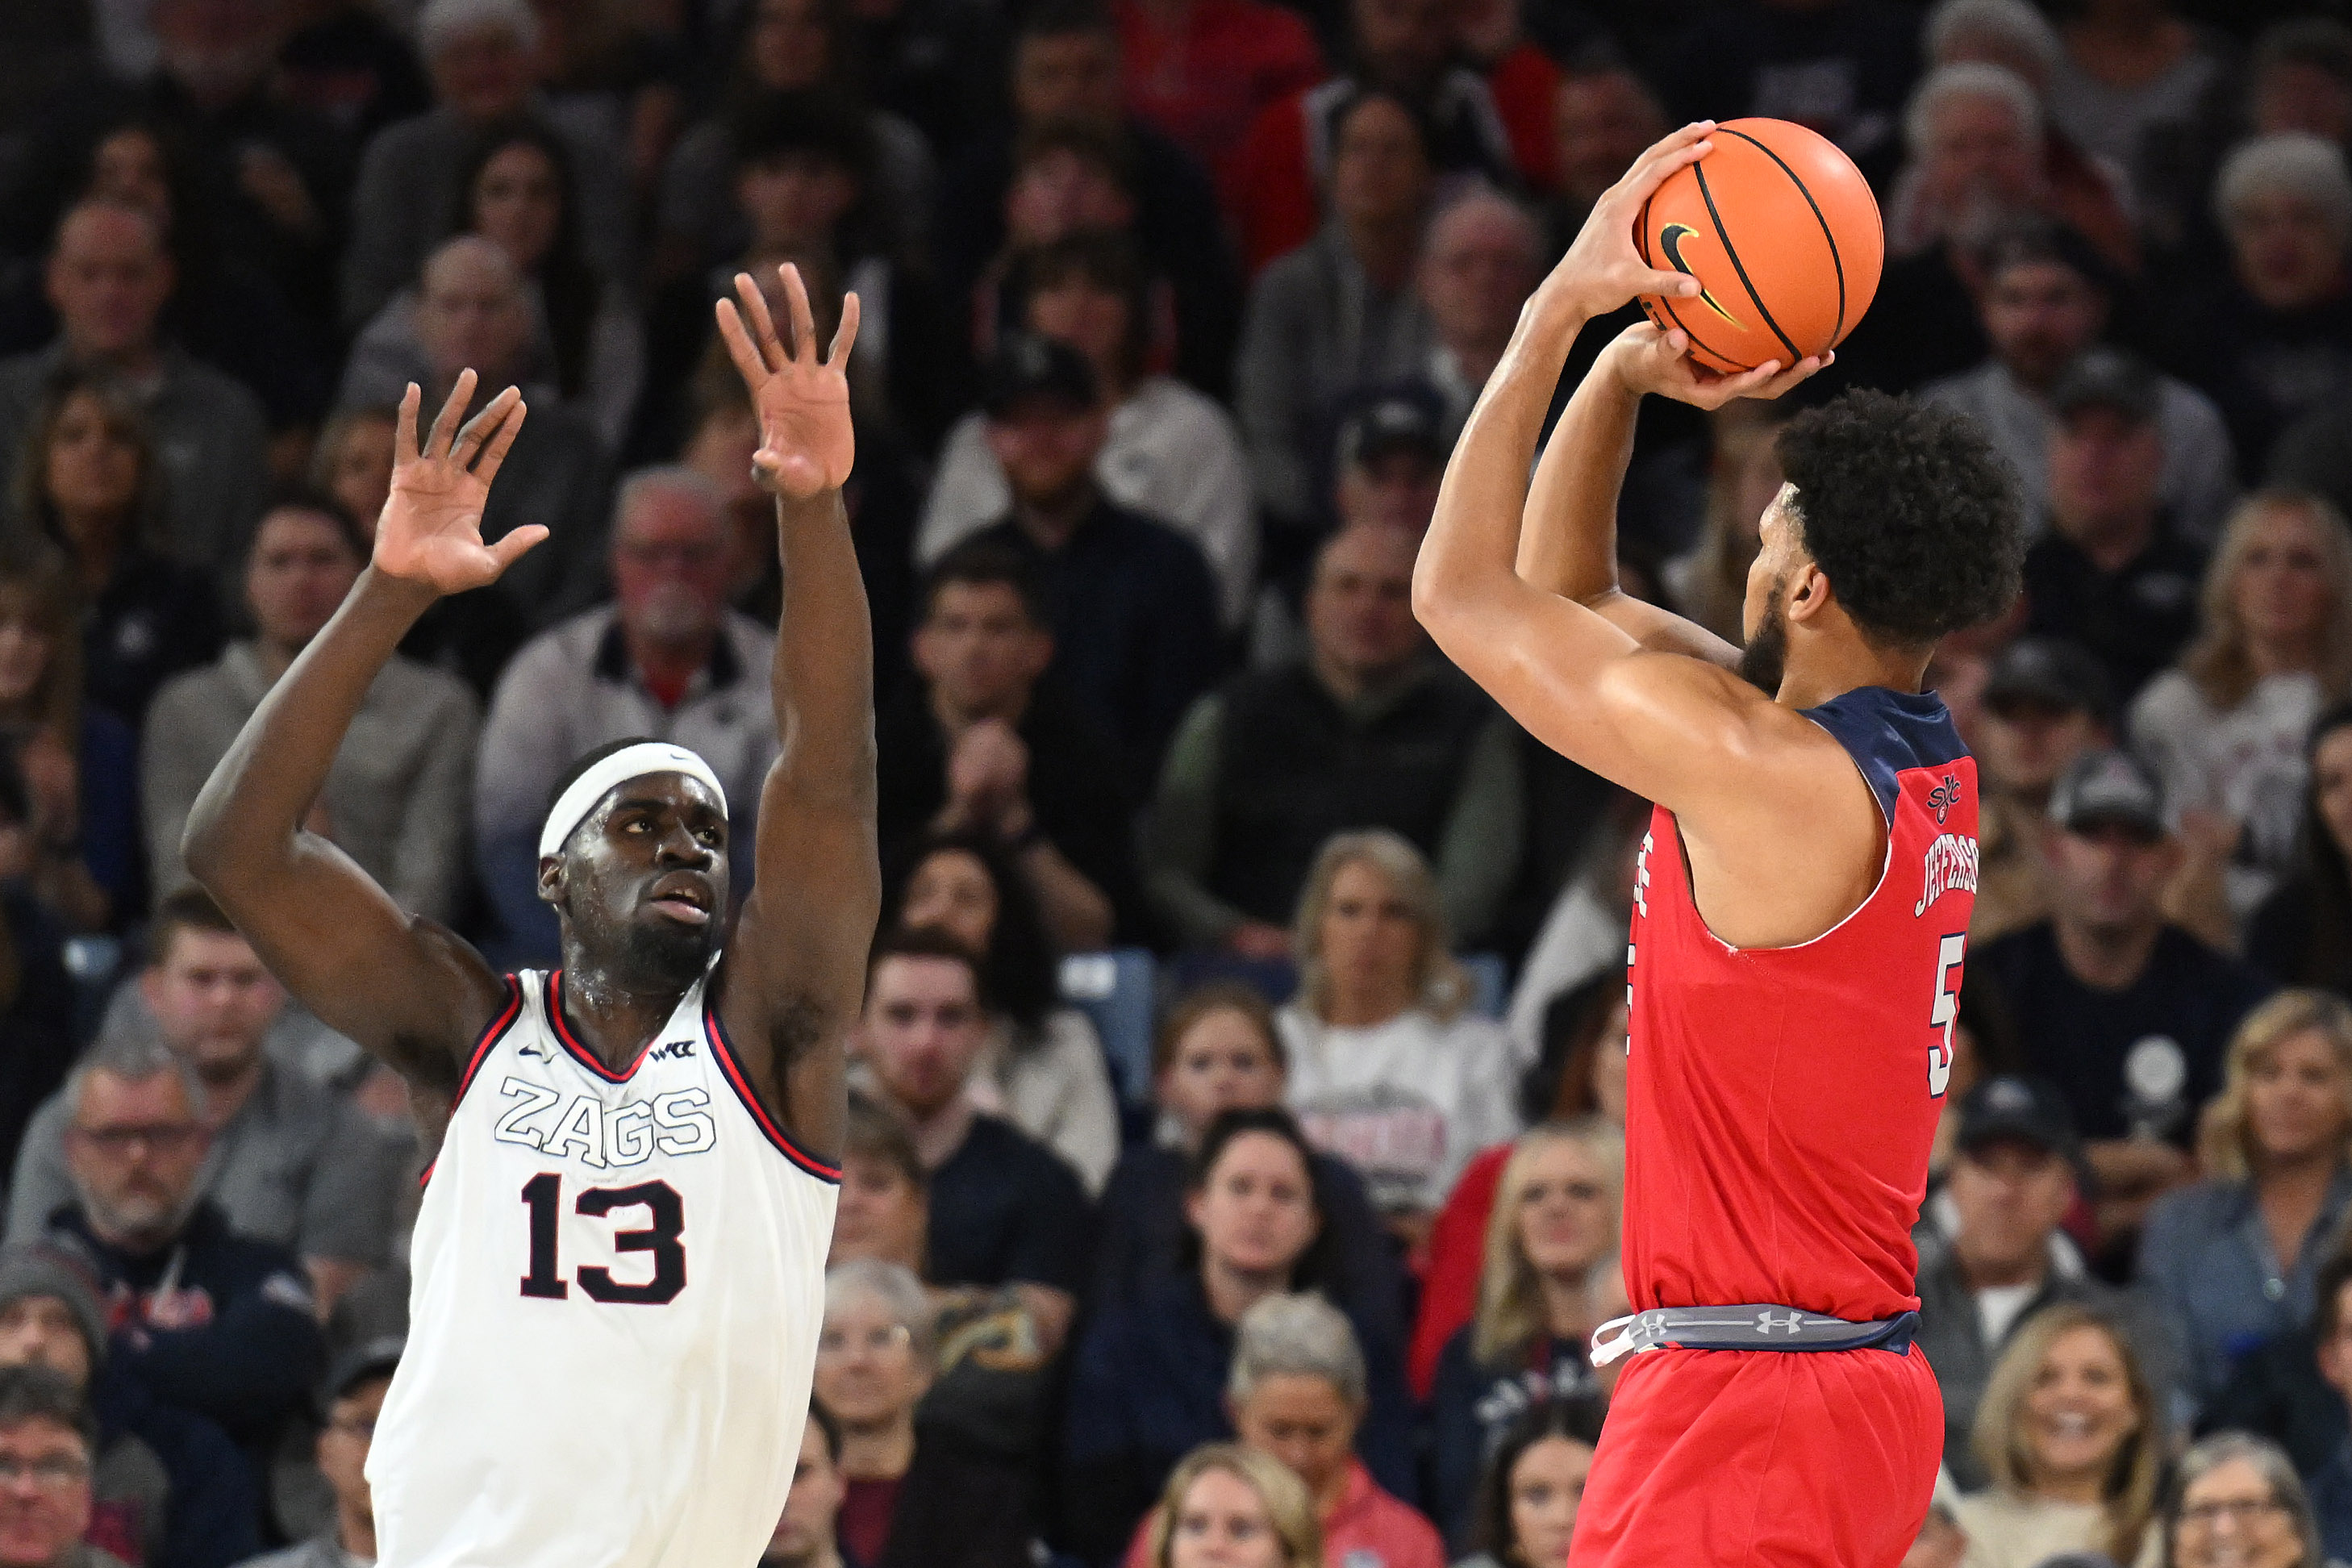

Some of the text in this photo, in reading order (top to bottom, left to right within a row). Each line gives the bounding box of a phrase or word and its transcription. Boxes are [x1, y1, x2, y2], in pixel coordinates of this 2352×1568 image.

[648, 1040, 696, 1063] WCC
[1927, 931, 1966, 1099] 5
[494, 1076, 717, 1170] ZAGS
[519, 1171, 687, 1305] 13
